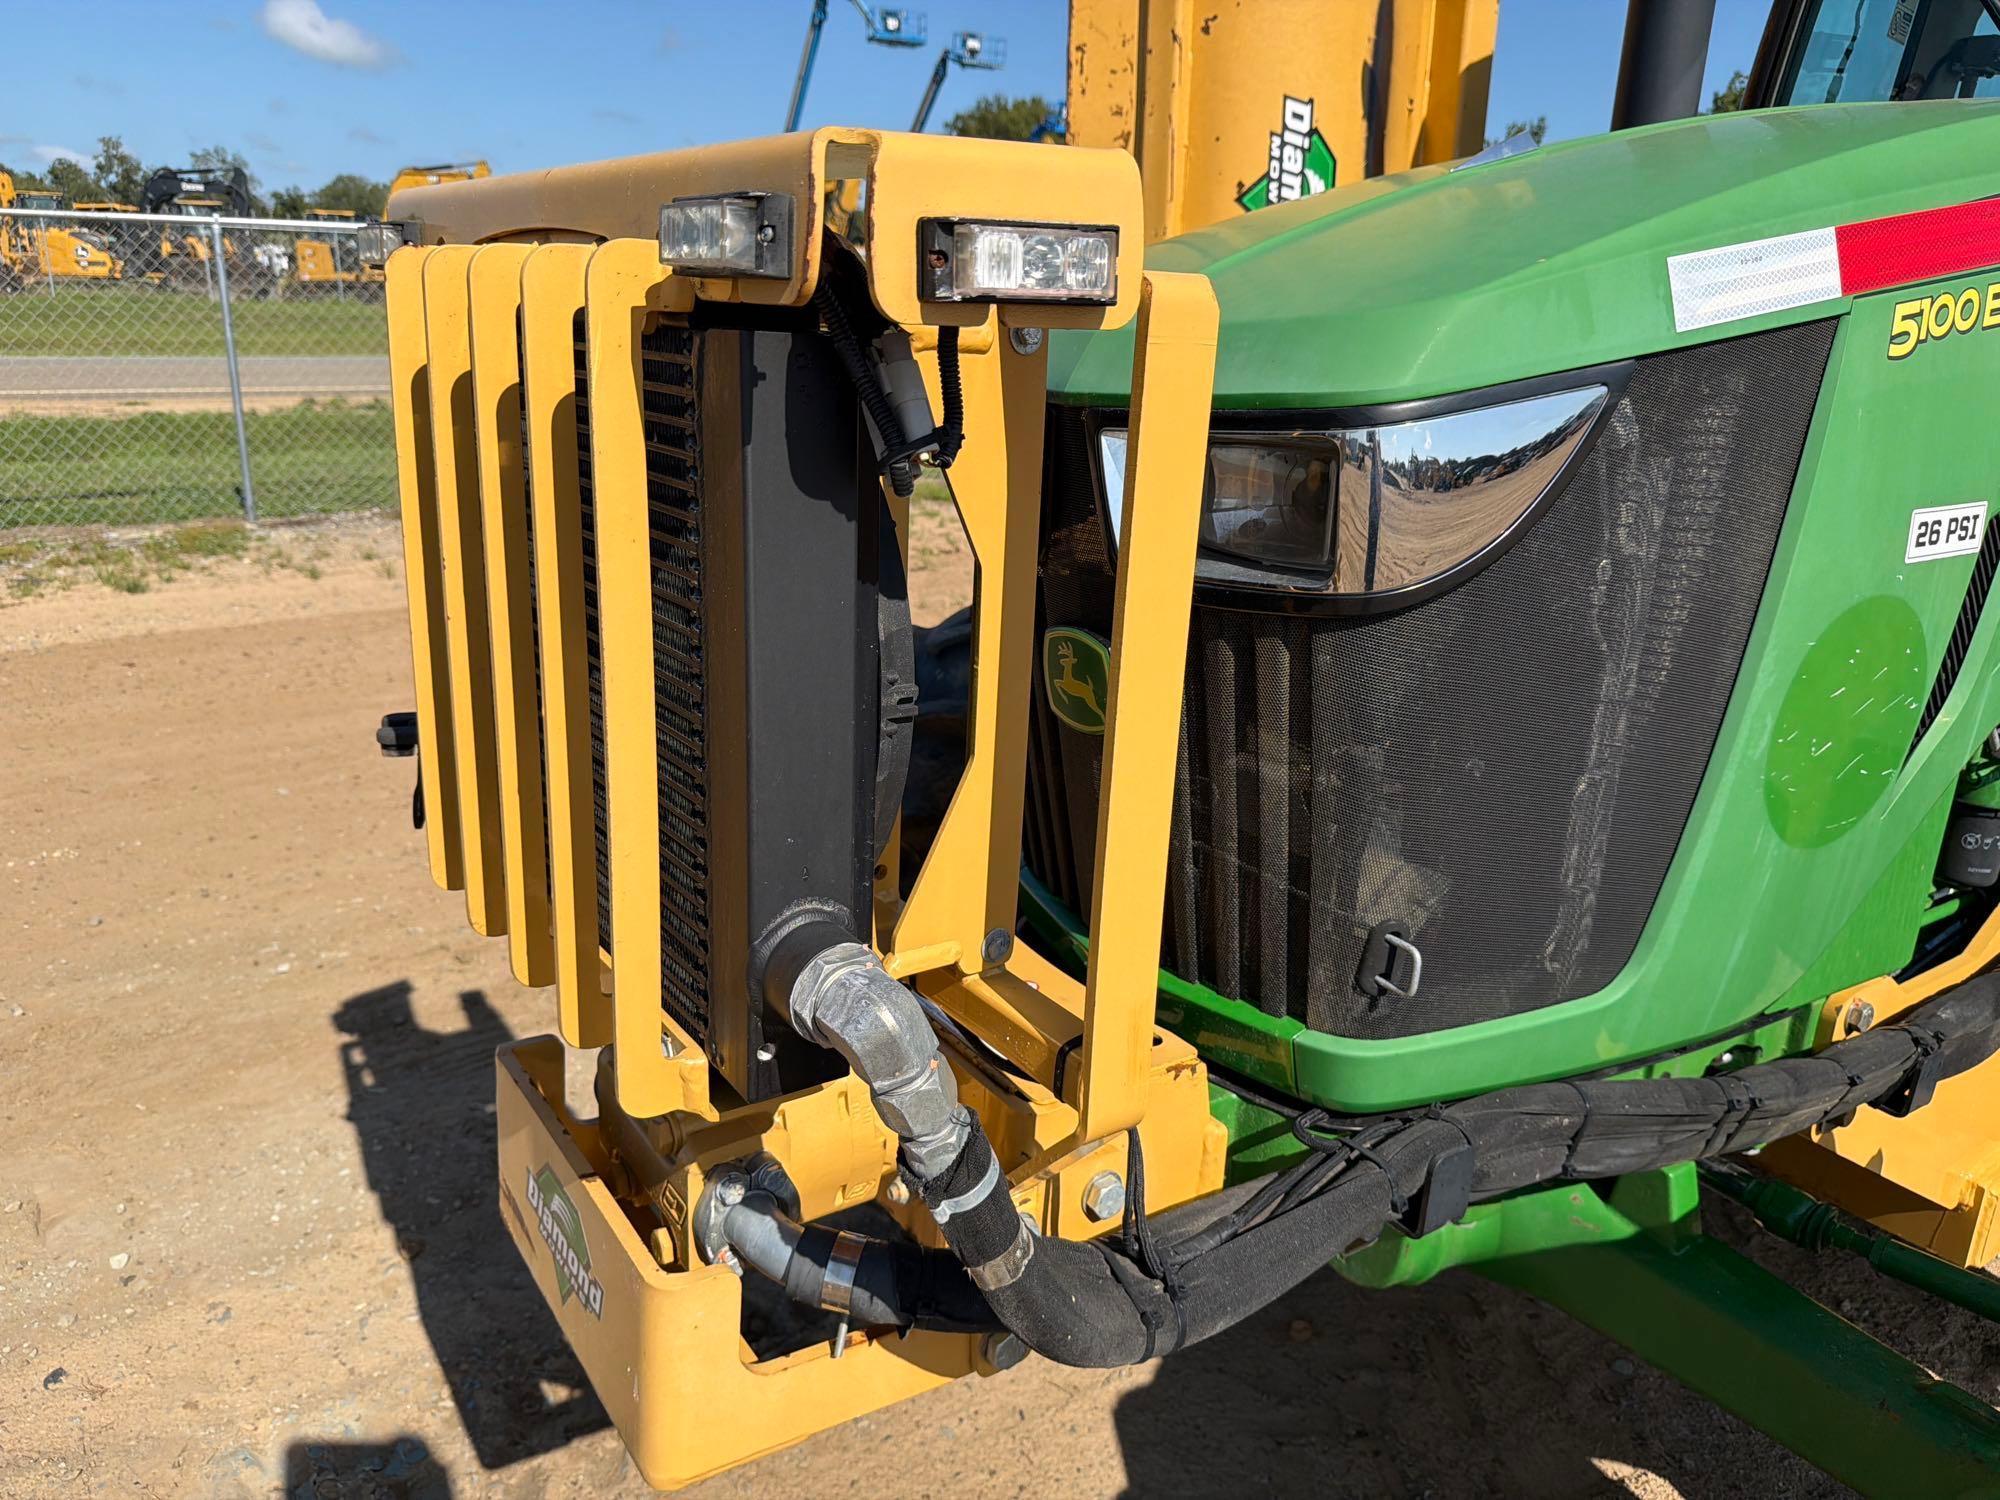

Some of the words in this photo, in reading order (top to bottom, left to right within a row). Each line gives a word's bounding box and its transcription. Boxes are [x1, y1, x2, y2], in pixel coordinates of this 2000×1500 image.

[1269, 134, 1280, 203] MOW
[1914, 519, 1942, 548] 26
[1945, 514, 1980, 544] PSI
[528, 1173, 602, 1314] Diamond
